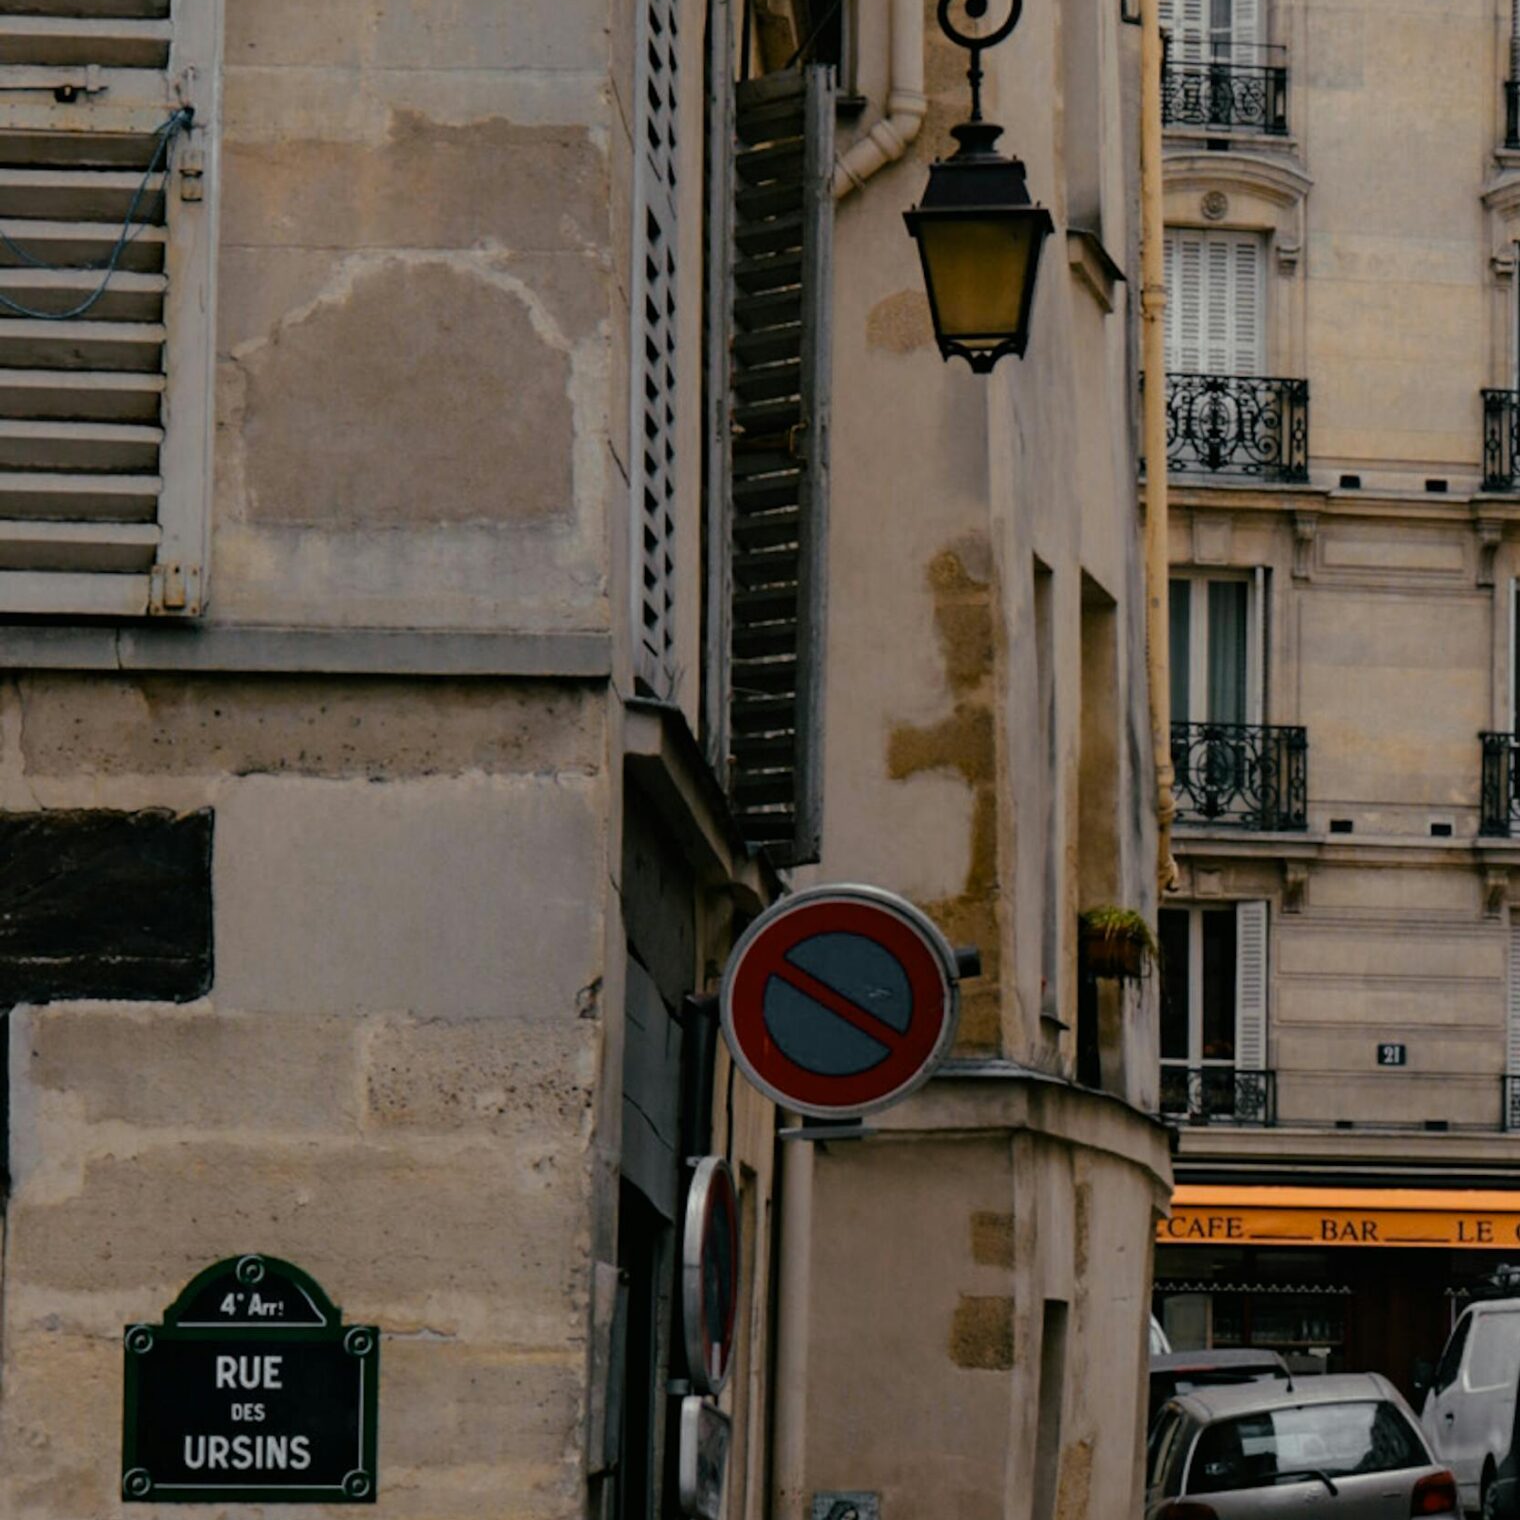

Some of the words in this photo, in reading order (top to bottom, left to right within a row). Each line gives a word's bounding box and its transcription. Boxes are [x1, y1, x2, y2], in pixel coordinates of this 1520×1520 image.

[1383, 1045, 1400, 1064] 21
[1167, 1216, 1244, 1239] CAFE
[1320, 1218, 1379, 1242] BAR
[1456, 1219, 1495, 1243] LE
[216, 1355, 283, 1389] RUE
[231, 1402, 266, 1422] DES
[184, 1435, 311, 1470] URSINS
